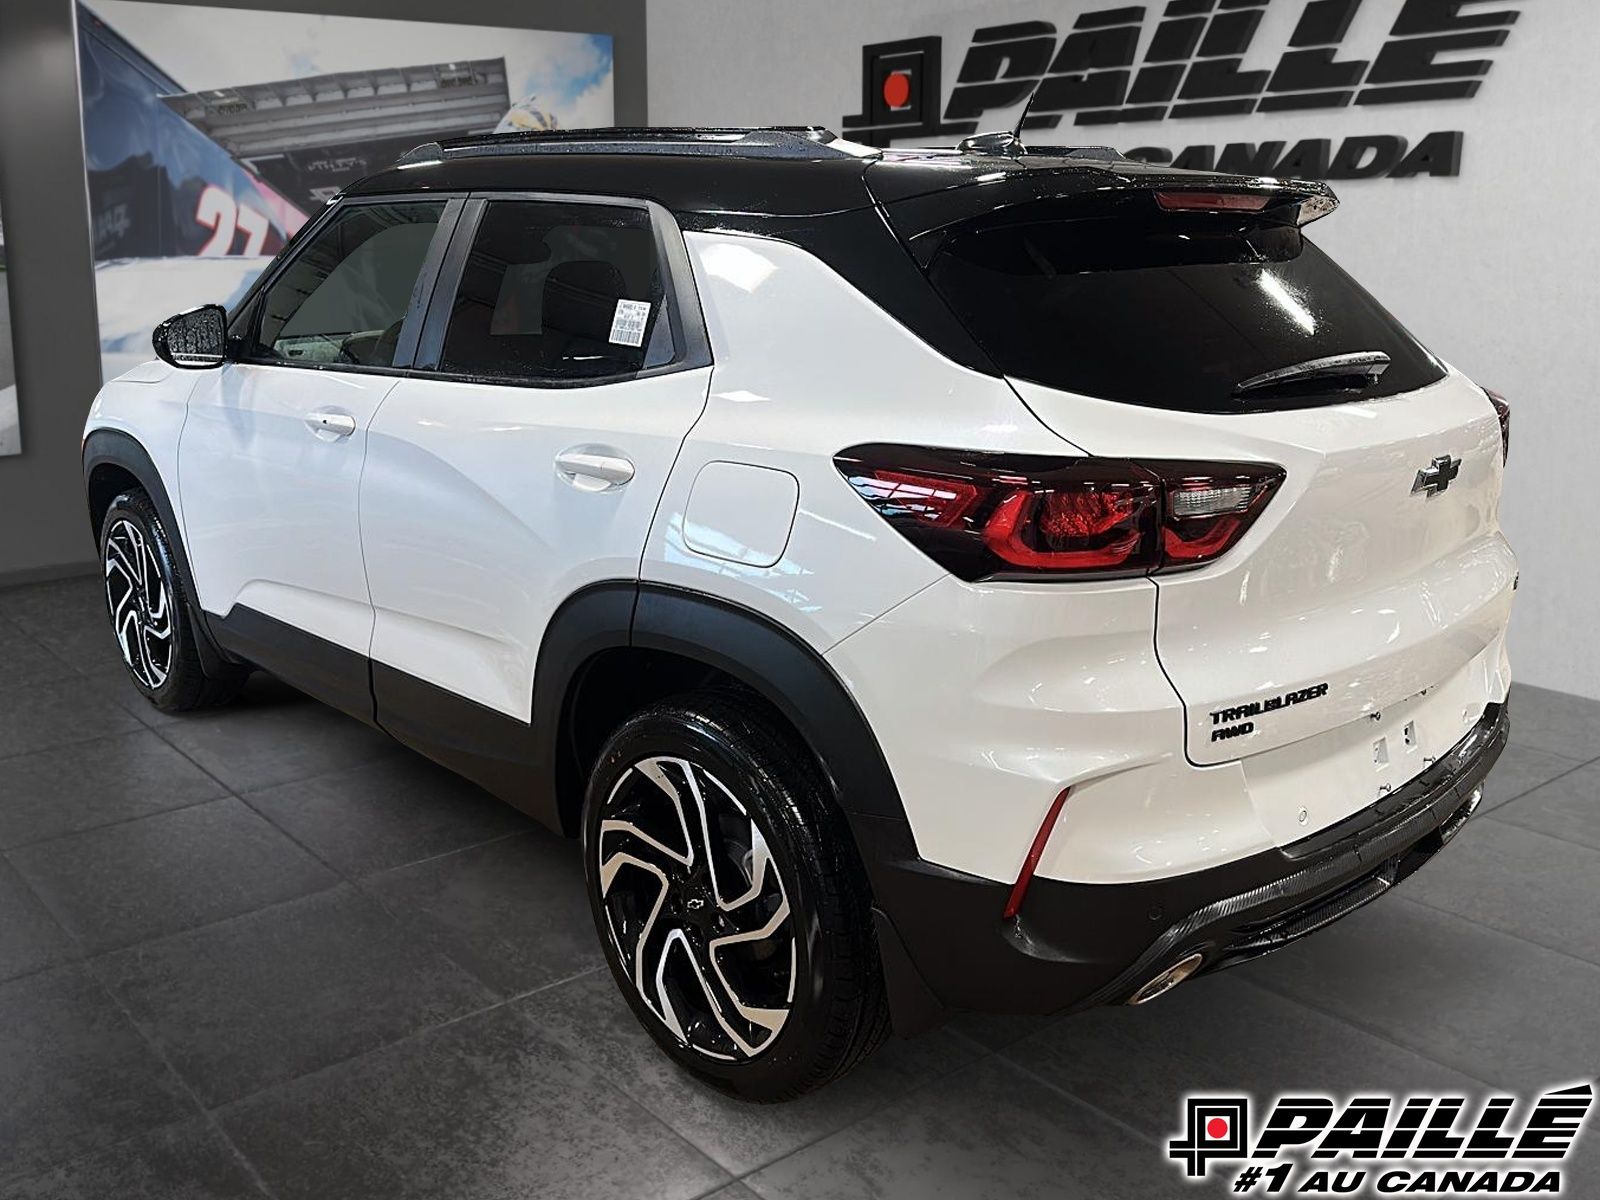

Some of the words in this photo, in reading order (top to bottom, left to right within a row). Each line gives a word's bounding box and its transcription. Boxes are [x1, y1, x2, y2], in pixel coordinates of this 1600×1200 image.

[197, 184, 269, 256] 27
[1209, 682, 1329, 725] TRAILBLAZER
[1211, 721, 1254, 743] AWD
